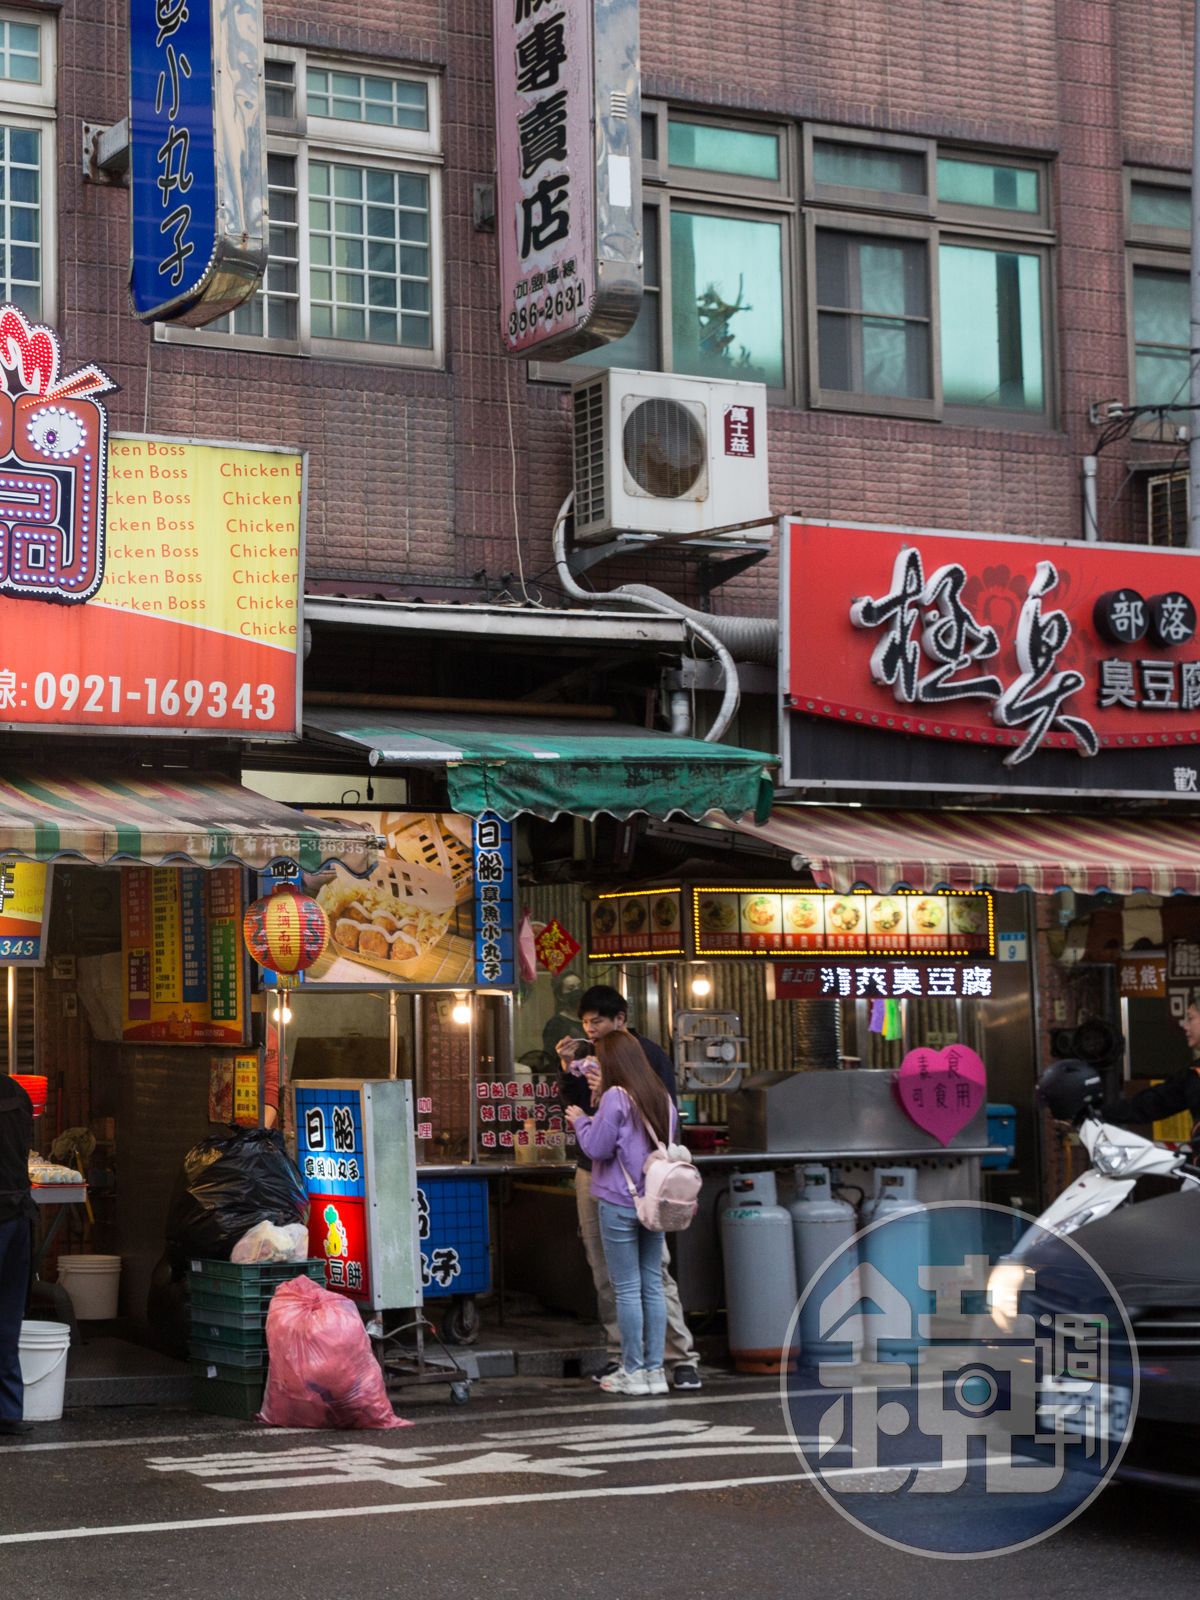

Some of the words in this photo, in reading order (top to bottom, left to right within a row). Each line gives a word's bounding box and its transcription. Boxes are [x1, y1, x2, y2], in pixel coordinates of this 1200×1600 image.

[515, 257, 568, 300] 加盟專線
[508, 281, 585, 338] 386-2631
[730, 407, 749, 453] 萬士益
[147, 442, 185, 456] Boss
[150, 465, 188, 479] Boss
[220, 463, 289, 477] Chicken
[153, 491, 191, 505] Boss
[223, 491, 292, 505] Chicken
[157, 517, 195, 531] Boss
[226, 519, 295, 533] Chicken
[161, 544, 199, 558] Boss
[230, 544, 299, 558] Chicken
[165, 570, 203, 584] Boss
[168, 597, 206, 611] Boss
[236, 596, 298, 609] Chicke
[1111, 592, 1193, 640] 部落
[477, 819, 503, 981] 日船章魚小丸子
[306, 1107, 356, 1153] 日船
[323, 1260, 363, 1289] 豆餅
